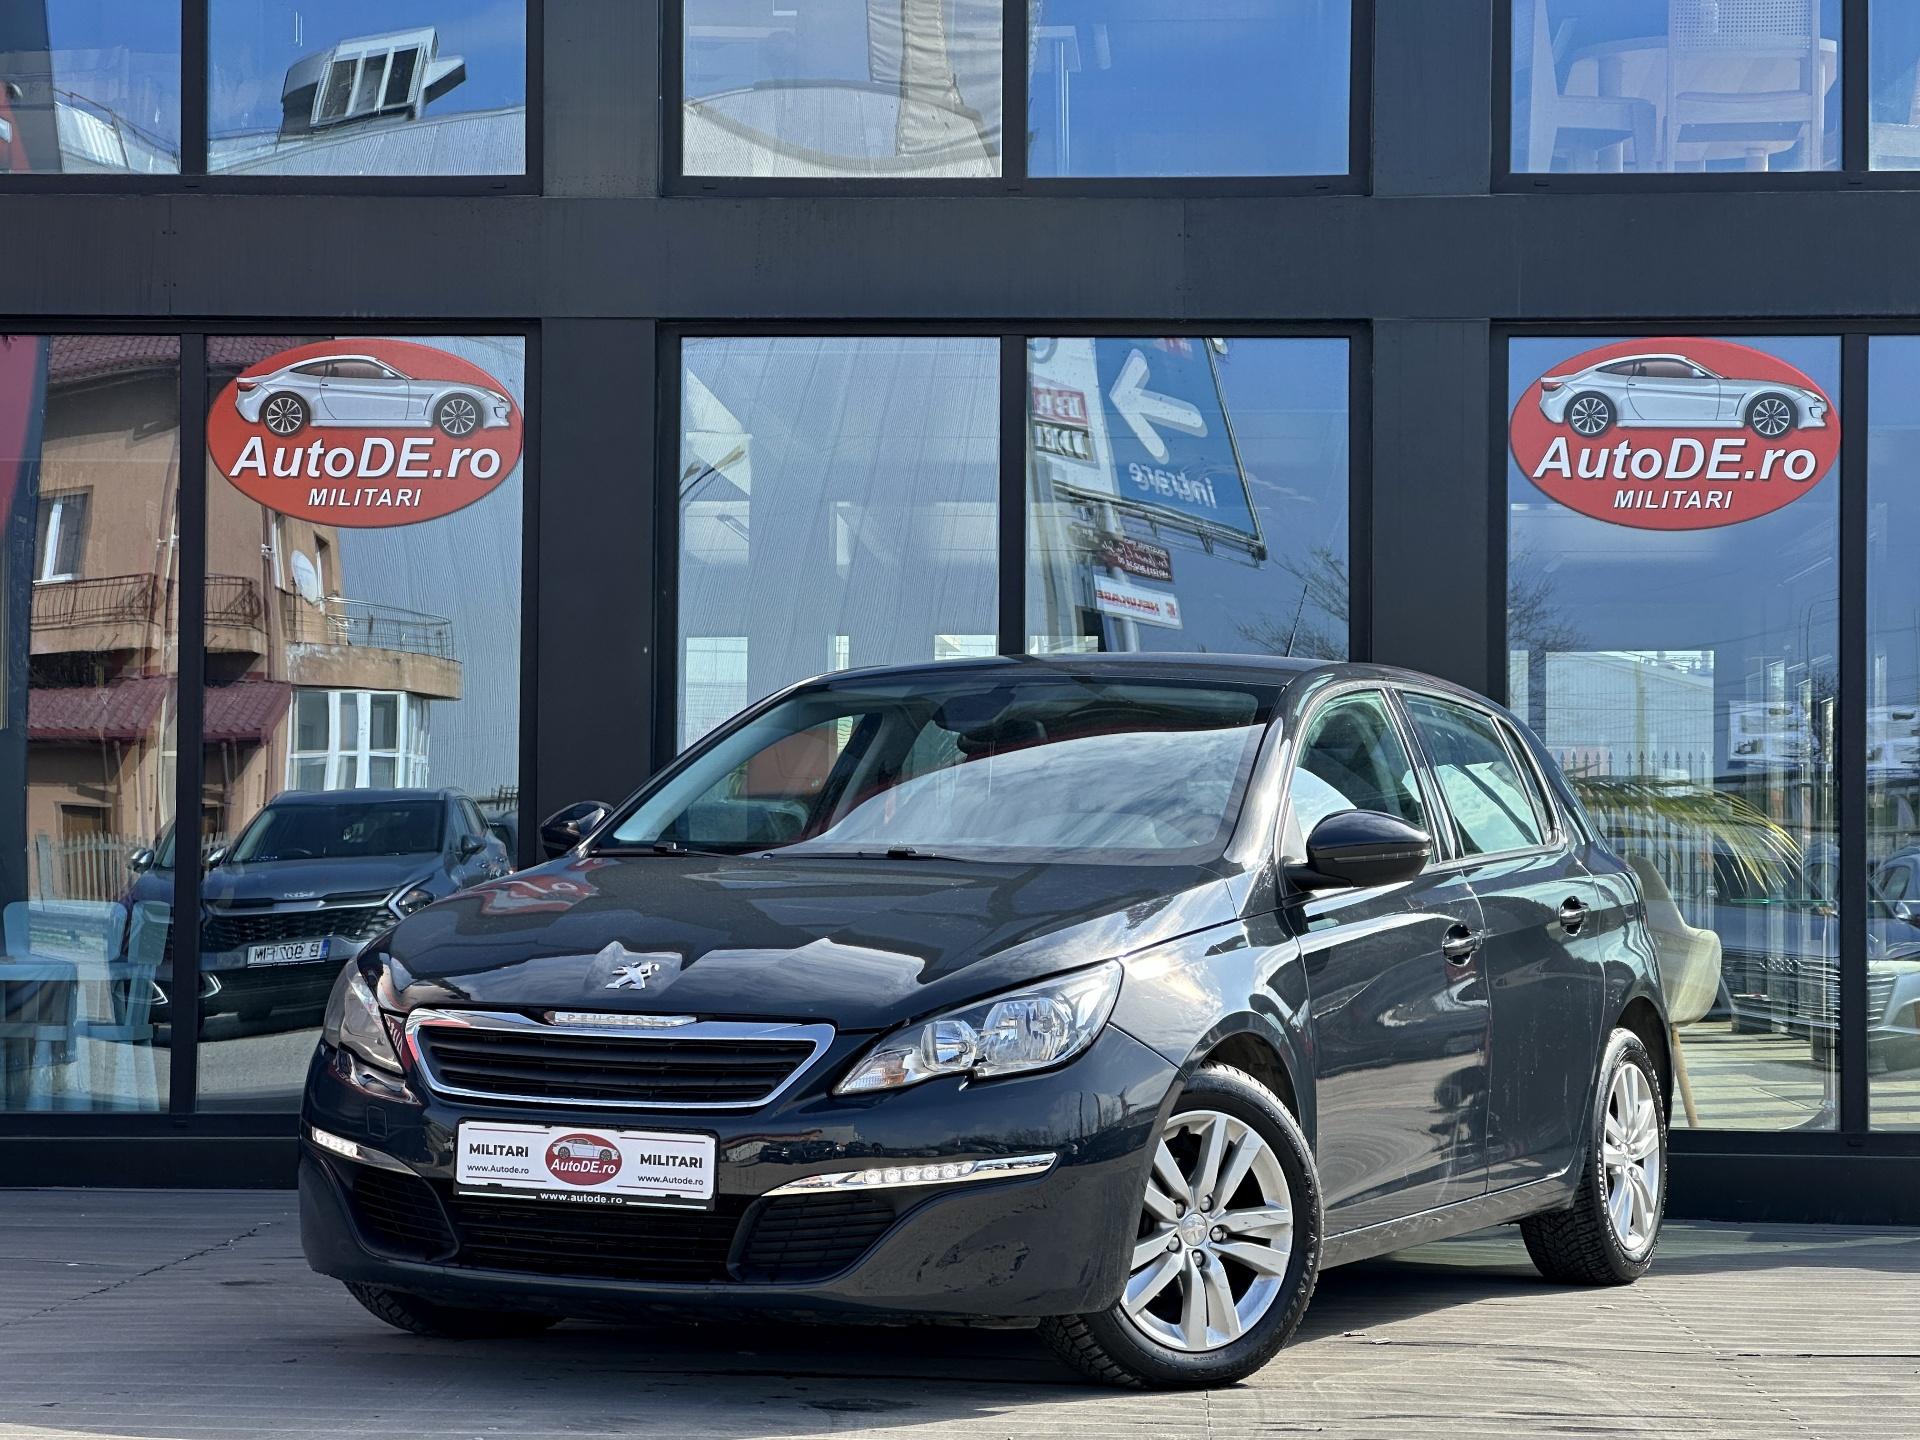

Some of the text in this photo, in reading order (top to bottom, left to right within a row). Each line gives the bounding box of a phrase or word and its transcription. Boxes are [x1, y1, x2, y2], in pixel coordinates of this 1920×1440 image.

[229, 436, 501, 479] AutoDE.ro
[1532, 436, 1817, 481] AutoDE.ro
[308, 488, 422, 507] MILITARI
[1613, 490, 1733, 510] MILITARI
[567, 1013, 659, 1025] PEUGEOT
[469, 1143, 529, 1158] MILITARI
[467, 1163, 530, 1175] www.Autode.ro
[550, 1158, 617, 1175] AutoDE.ro
[639, 1153, 703, 1169] MILITARI
[637, 1174, 704, 1186] www.Autode.ro
[540, 1191, 623, 1204] www.autode.ro
